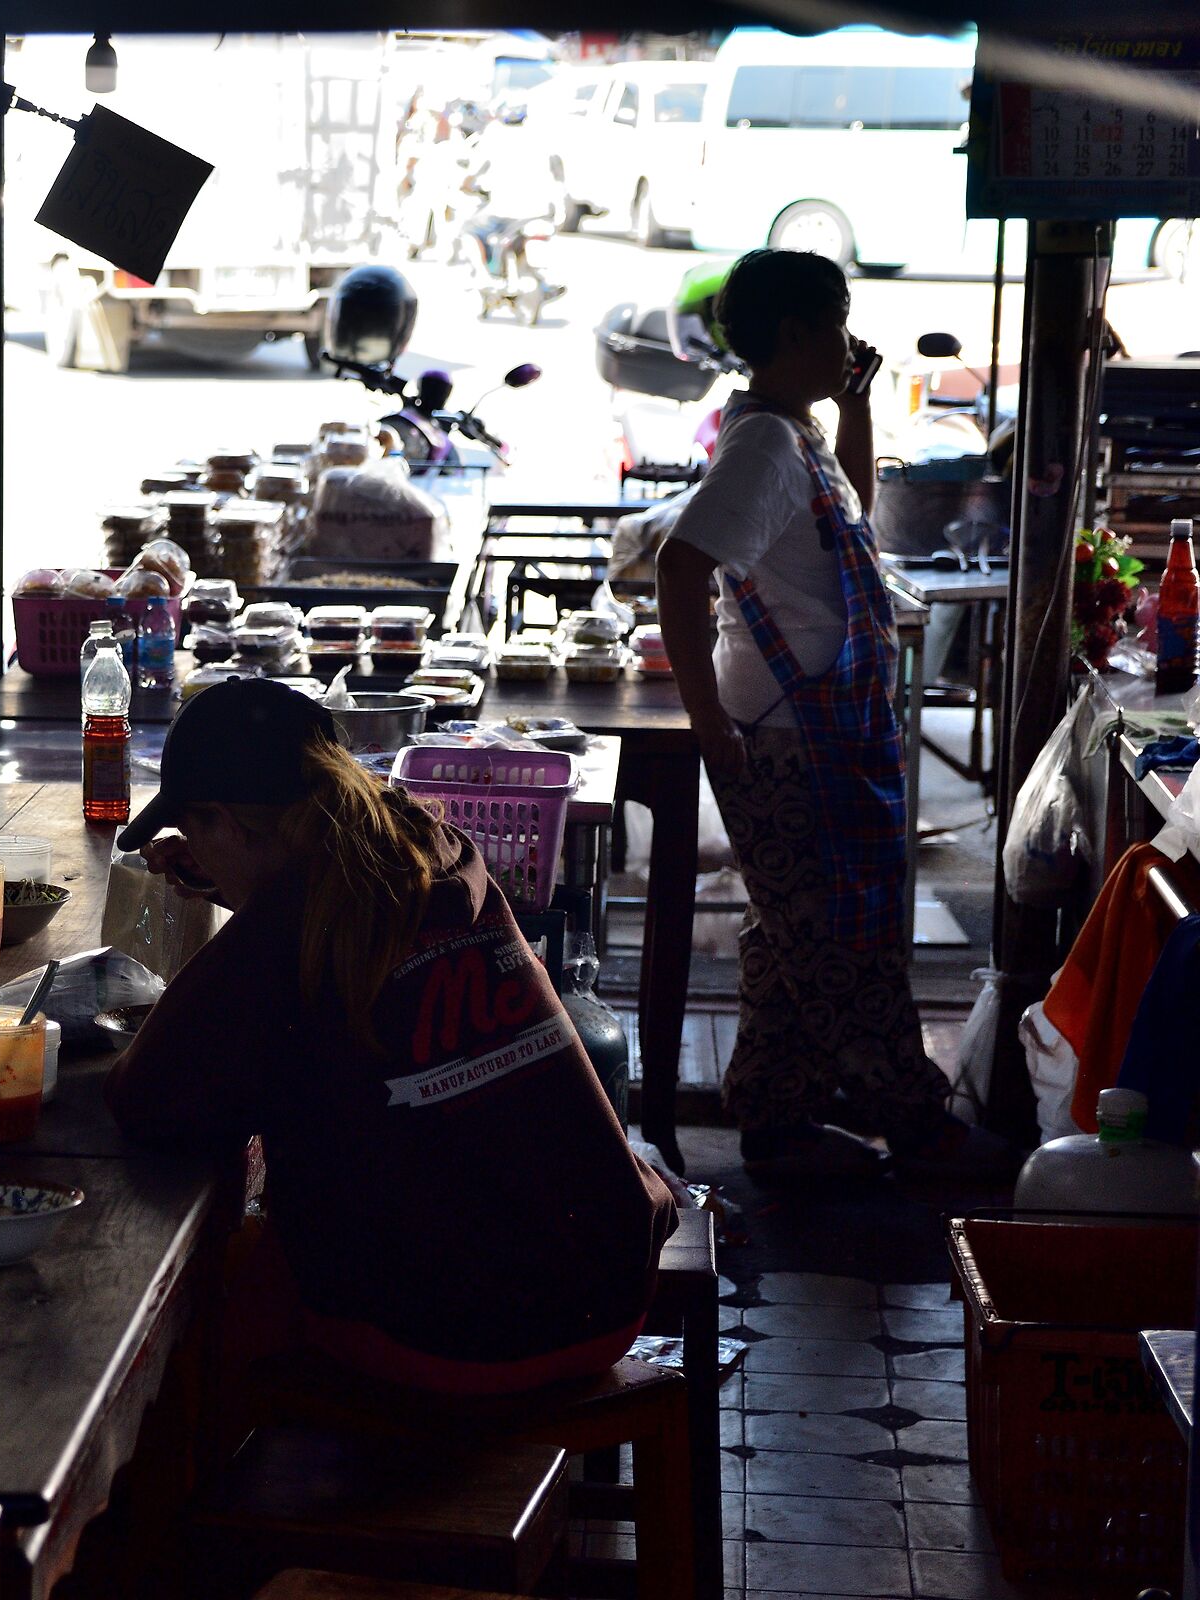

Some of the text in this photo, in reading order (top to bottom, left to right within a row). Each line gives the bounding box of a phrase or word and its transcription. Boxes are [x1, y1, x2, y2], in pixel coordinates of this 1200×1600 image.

[1080, 108, 1091, 124] 4
[1114, 107, 1123, 123] 5
[1145, 108, 1156, 123] 6
[1044, 126, 1060, 142] 10
[1074, 126, 1090, 142] 11
[1139, 126, 1155, 142] 13
[1172, 126, 1186, 142] 14
[1044, 143, 1060, 159] 17
[1074, 143, 1090, 160] 18
[1105, 143, 1122, 159] 19
[1136, 143, 1155, 160] 20
[1169, 143, 1186, 160] 21
[1043, 160, 1061, 177] 24
[1073, 160, 1091, 177] 25
[1104, 161, 1122, 177] 26
[1135, 161, 1155, 177] 27
[1168, 161, 1186, 177] 28
[392, 947, 438, 980] GENUINE
[450, 930, 506, 952] AUTHENTIC
[418, 1029, 563, 1098] MANUFACTURED TO LAST
